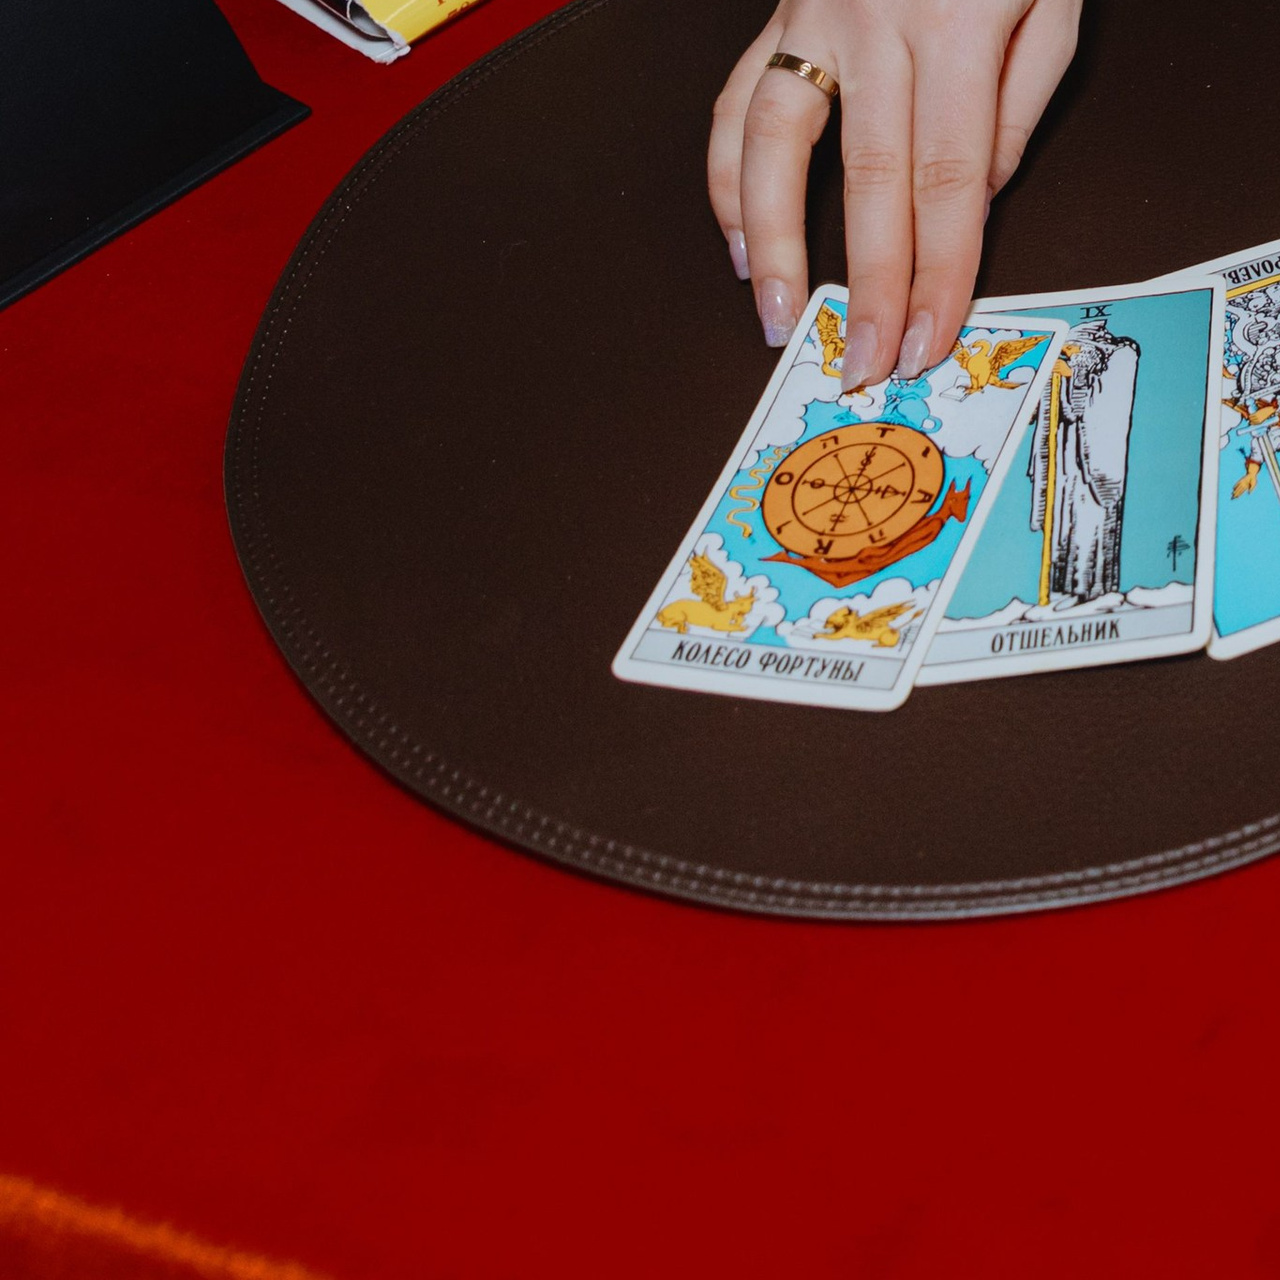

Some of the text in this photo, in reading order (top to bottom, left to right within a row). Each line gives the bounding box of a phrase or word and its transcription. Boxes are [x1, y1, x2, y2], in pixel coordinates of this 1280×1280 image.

[1080, 303, 1112, 319] IX
[990, 618, 1121, 653] ОТШЕЛЬНИК
[670, 639, 866, 682] КОЛЕСО ФОРТУНЫ
